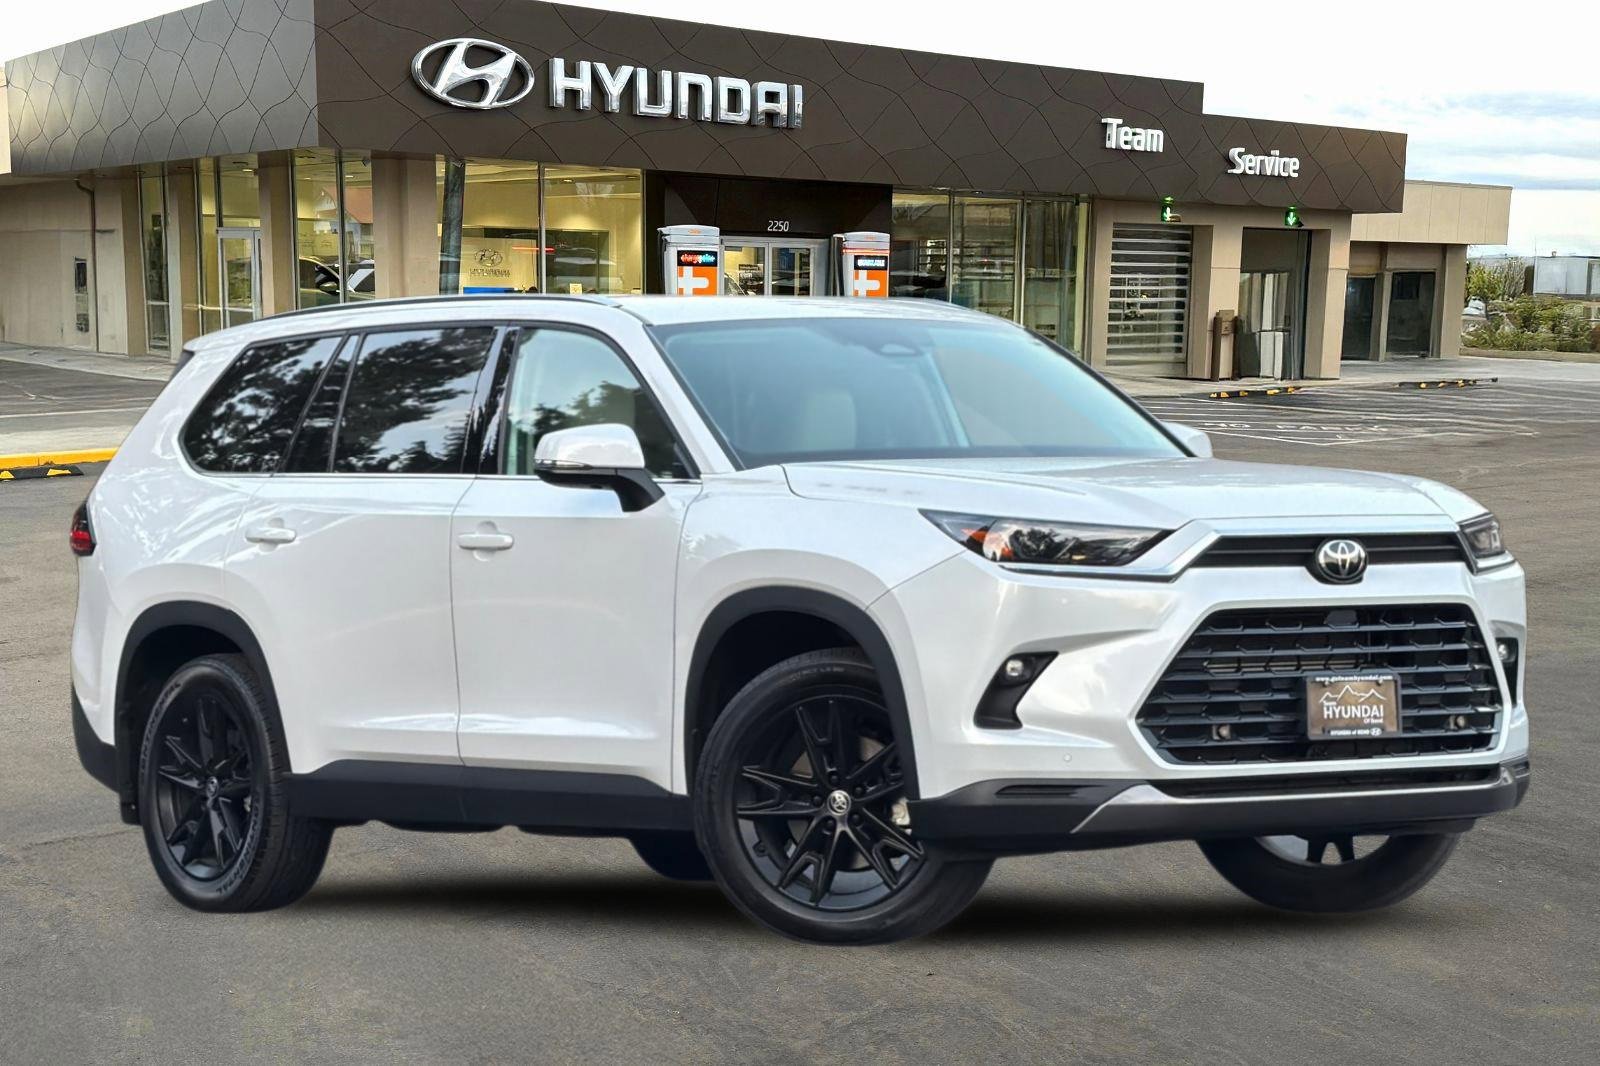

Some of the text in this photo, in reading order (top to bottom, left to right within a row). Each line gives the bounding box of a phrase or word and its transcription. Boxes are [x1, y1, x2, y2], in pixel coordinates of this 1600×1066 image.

[549, 57, 803, 129] HYUNDAI
[1101, 117, 1164, 152] Team
[1227, 147, 1300, 178] Service
[767, 220, 790, 232] 2250
[1323, 705, 1384, 719] HYUNDAI
